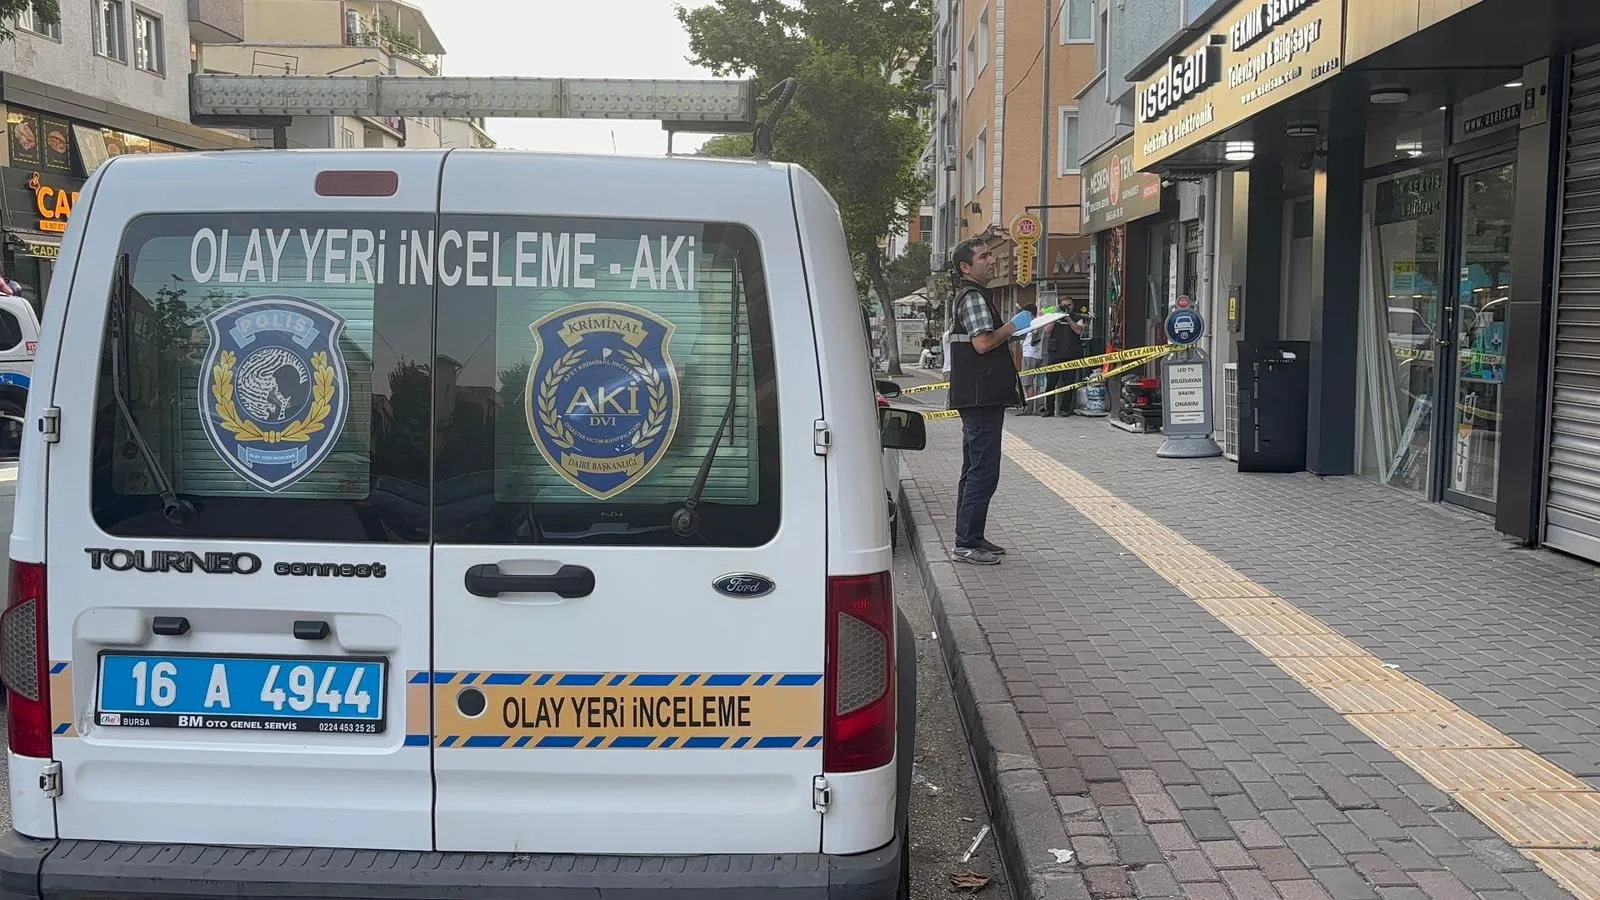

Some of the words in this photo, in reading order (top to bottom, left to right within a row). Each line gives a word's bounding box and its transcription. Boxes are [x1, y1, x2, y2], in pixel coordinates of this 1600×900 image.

[1138, 45, 1208, 123] uselsan
[37, 187, 80, 219] CA
[33, 245, 59, 257] CADD
[190, 228, 291, 283] OLAY
[84, 547, 262, 574] TOURNEO
[273, 560, 387, 578] connect
[726, 579, 760, 593] Ford
[132, 661, 178, 707] 16
[203, 663, 231, 709] A
[260, 665, 371, 714] 4944
[123, 717, 150, 727] BURSA
[178, 715, 203, 728] BM
[206, 720, 228, 729] OTO
[230, 720, 263, 730] GENEL
[319, 722, 338, 732] 0224
[339, 723, 354, 732] 453
[354, 724, 365, 733] 25
[365, 724, 376, 733] 25
[502, 696, 565, 729] OLAY
